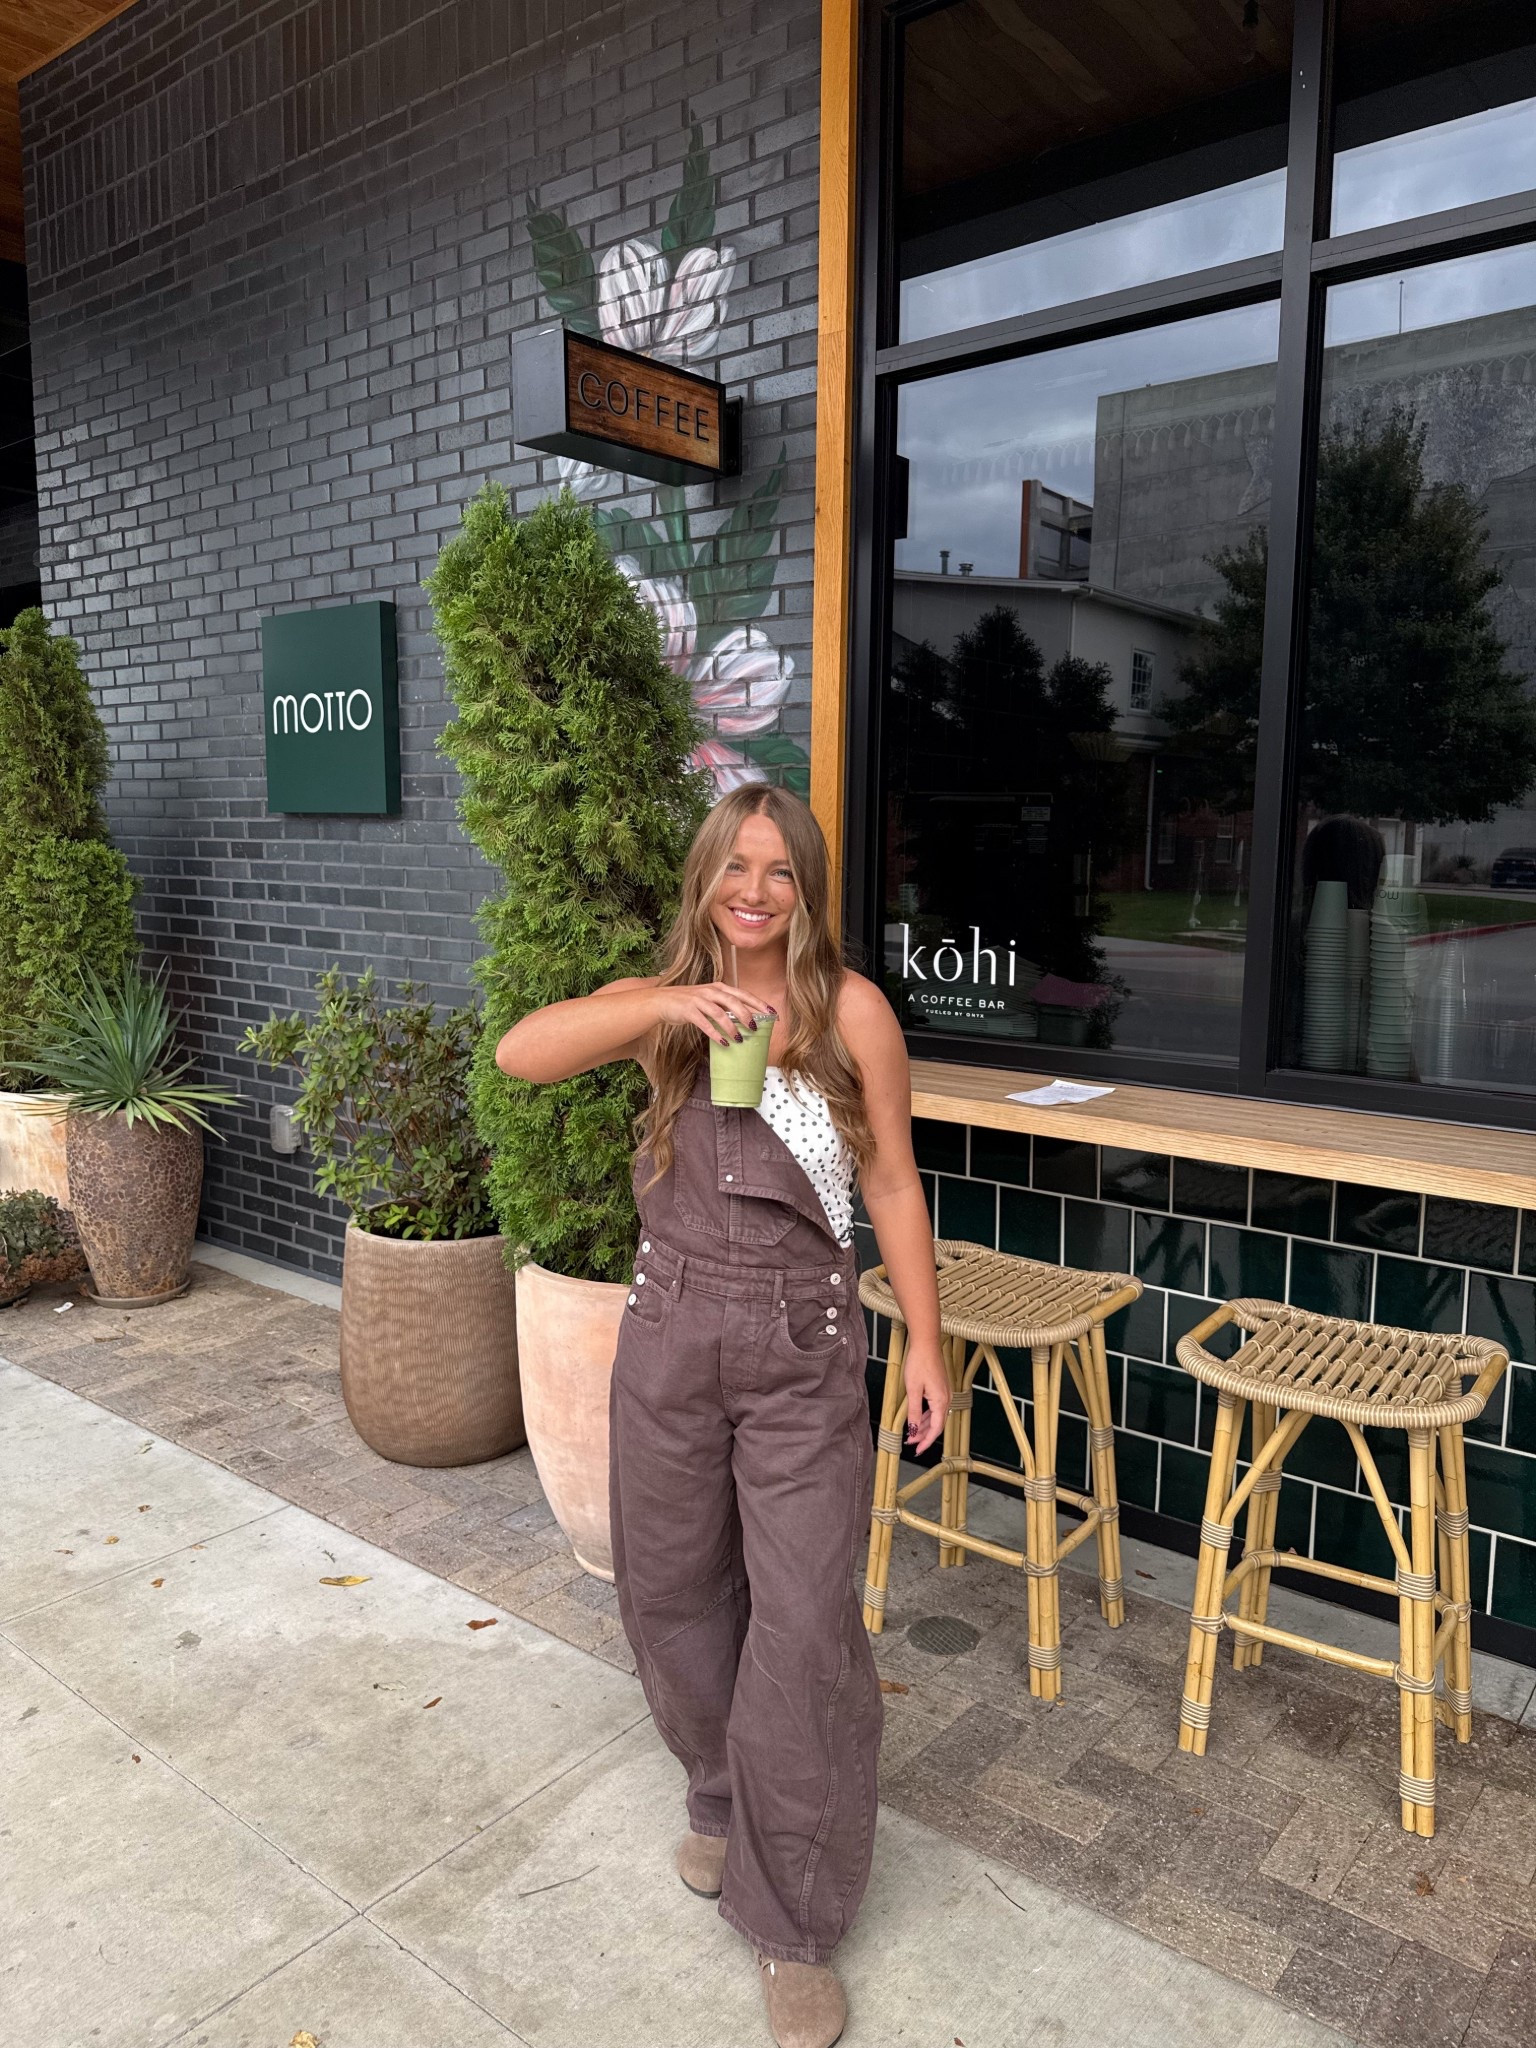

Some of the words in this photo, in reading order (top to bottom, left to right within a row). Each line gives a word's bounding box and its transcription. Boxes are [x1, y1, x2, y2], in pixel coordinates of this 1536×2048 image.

[577, 371, 710, 443] COFFEE
[898, 922, 1016, 987] kōhi
[907, 993, 916, 1003] A
[920, 994, 973, 1008] COFFEE
[978, 999, 1006, 1010] BAR
[925, 1008, 952, 1016] FUELED
